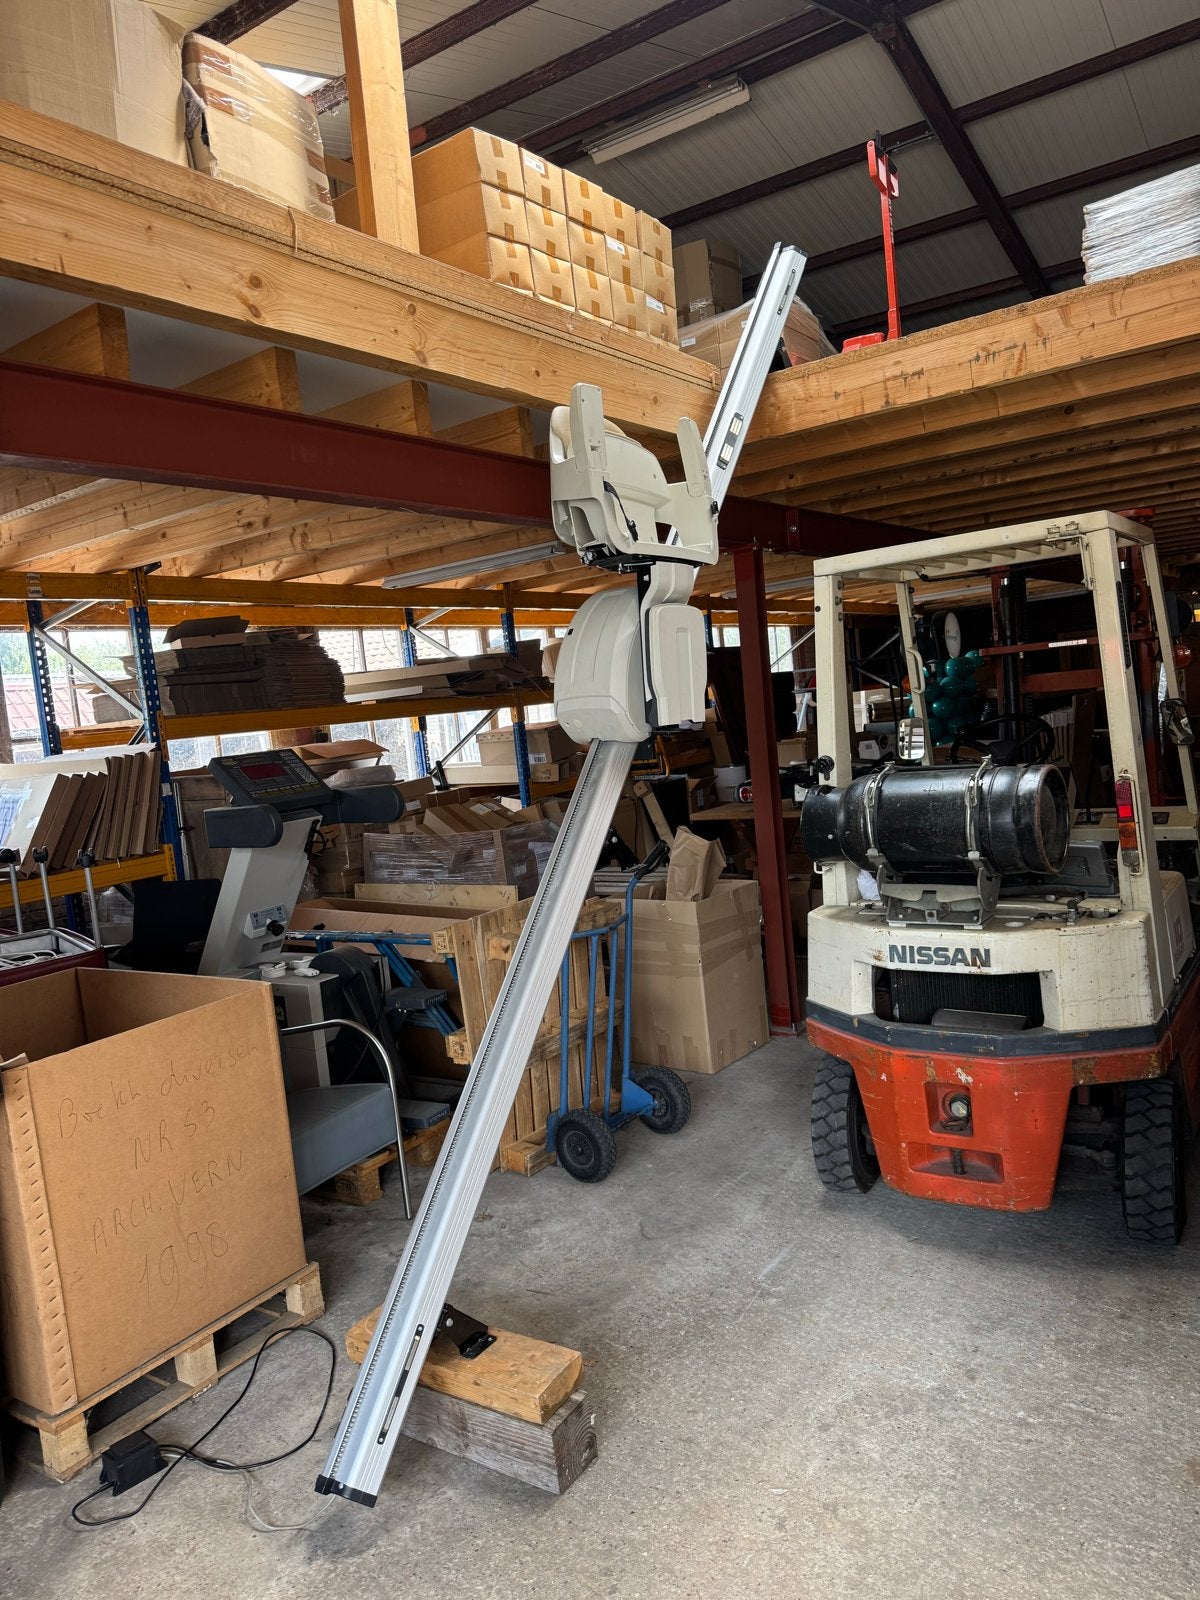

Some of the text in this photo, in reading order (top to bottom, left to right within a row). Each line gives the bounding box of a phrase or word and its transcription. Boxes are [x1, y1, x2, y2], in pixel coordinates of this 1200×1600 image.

[889, 944, 991, 968] NISSAN
[134, 1119, 174, 1170] NR
[168, 1150, 243, 1206] VERN
[139, 1222, 229, 1312] 1998
